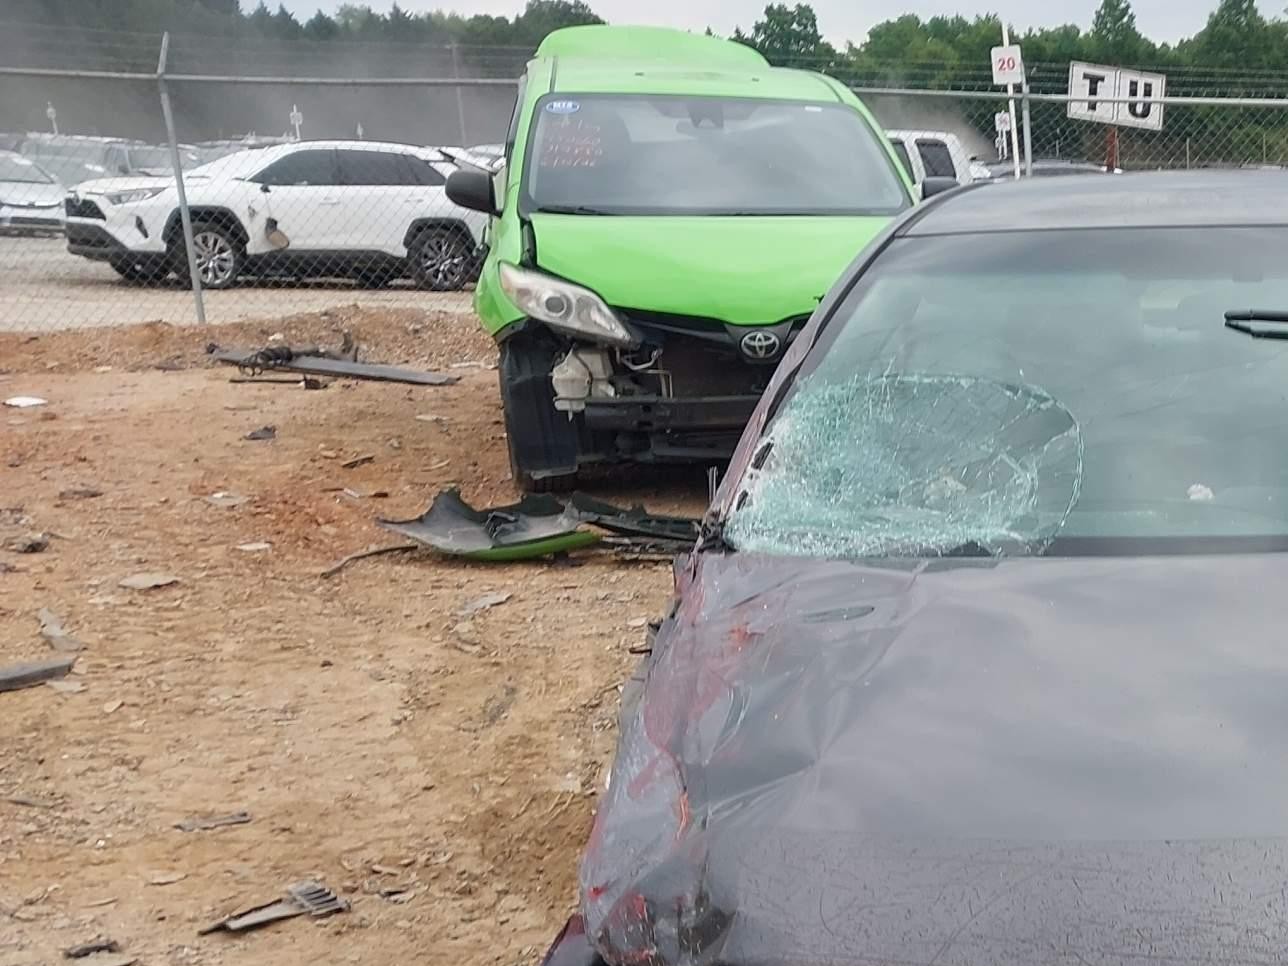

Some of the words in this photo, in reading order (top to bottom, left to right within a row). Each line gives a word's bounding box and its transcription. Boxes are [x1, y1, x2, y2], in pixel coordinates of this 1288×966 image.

[997, 57, 1016, 72] 20
[1081, 71, 1106, 112] T
[1127, 79, 1154, 119] U
